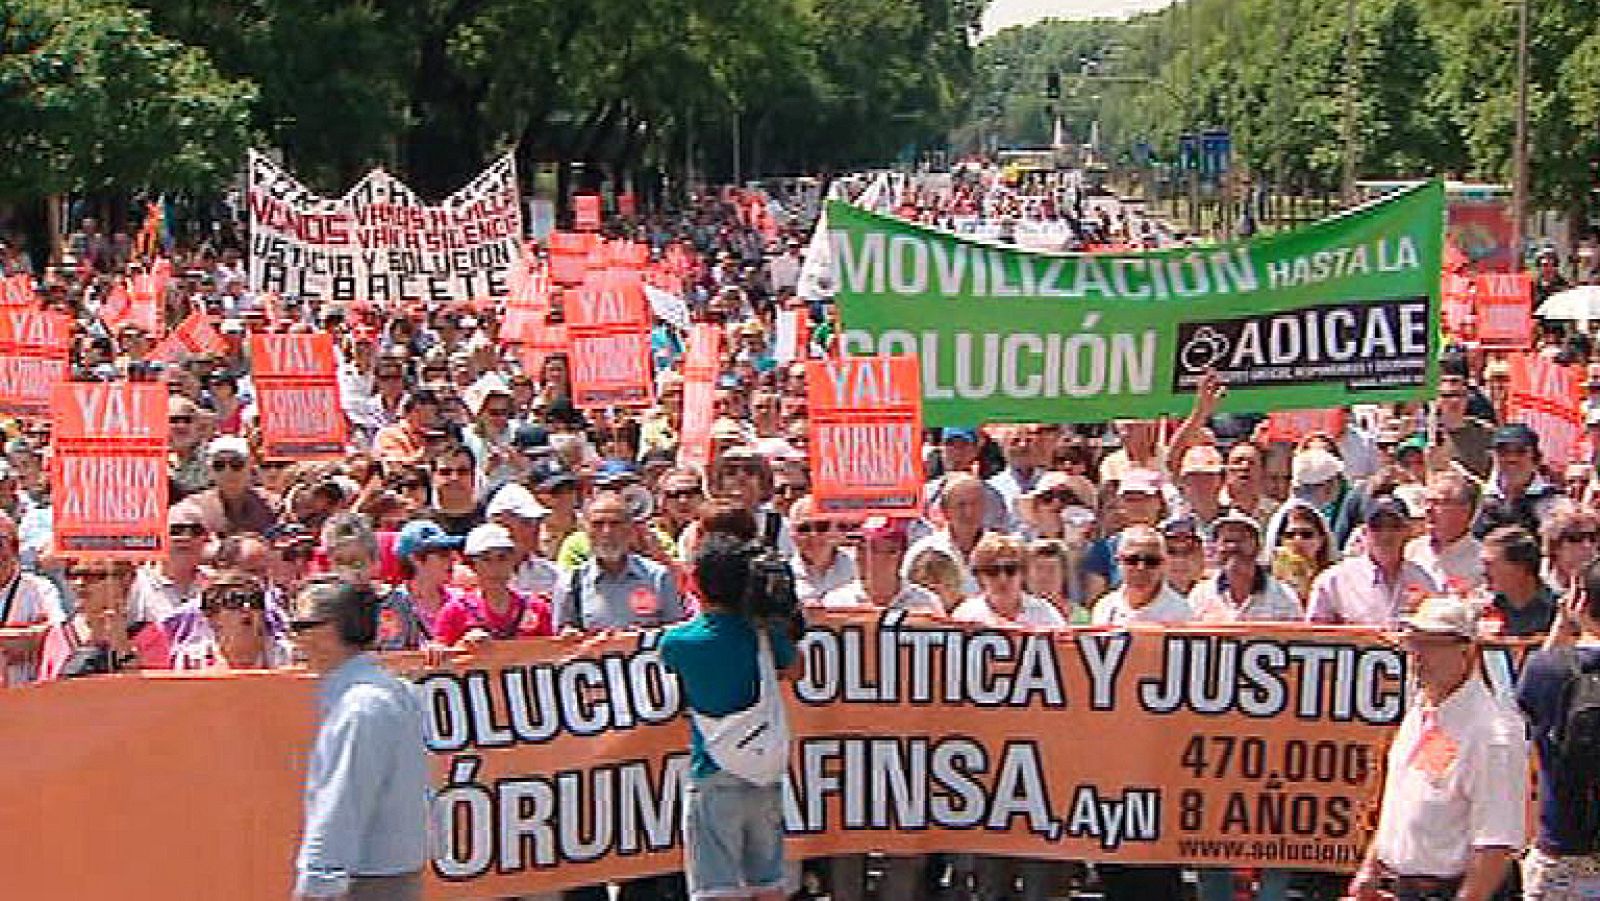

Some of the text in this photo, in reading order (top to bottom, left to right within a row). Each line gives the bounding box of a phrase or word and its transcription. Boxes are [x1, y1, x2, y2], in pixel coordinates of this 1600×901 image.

[263, 261, 511, 301] ALBACETE
[361, 250, 377, 269] Y
[1266, 244, 1370, 289] HASTA
[1377, 235, 1420, 272] LA
[1230, 301, 1426, 369] ADICAE
[421, 630, 683, 752] OLUCIÓ
[794, 610, 1064, 710] OLÍTICA
[1076, 630, 1131, 712] Y
[1138, 634, 1404, 727] JUSTIC
[430, 754, 691, 882] ÓRUM
[1069, 784, 1161, 848] AyN
[1180, 780, 1352, 838] 8 AÑOS
